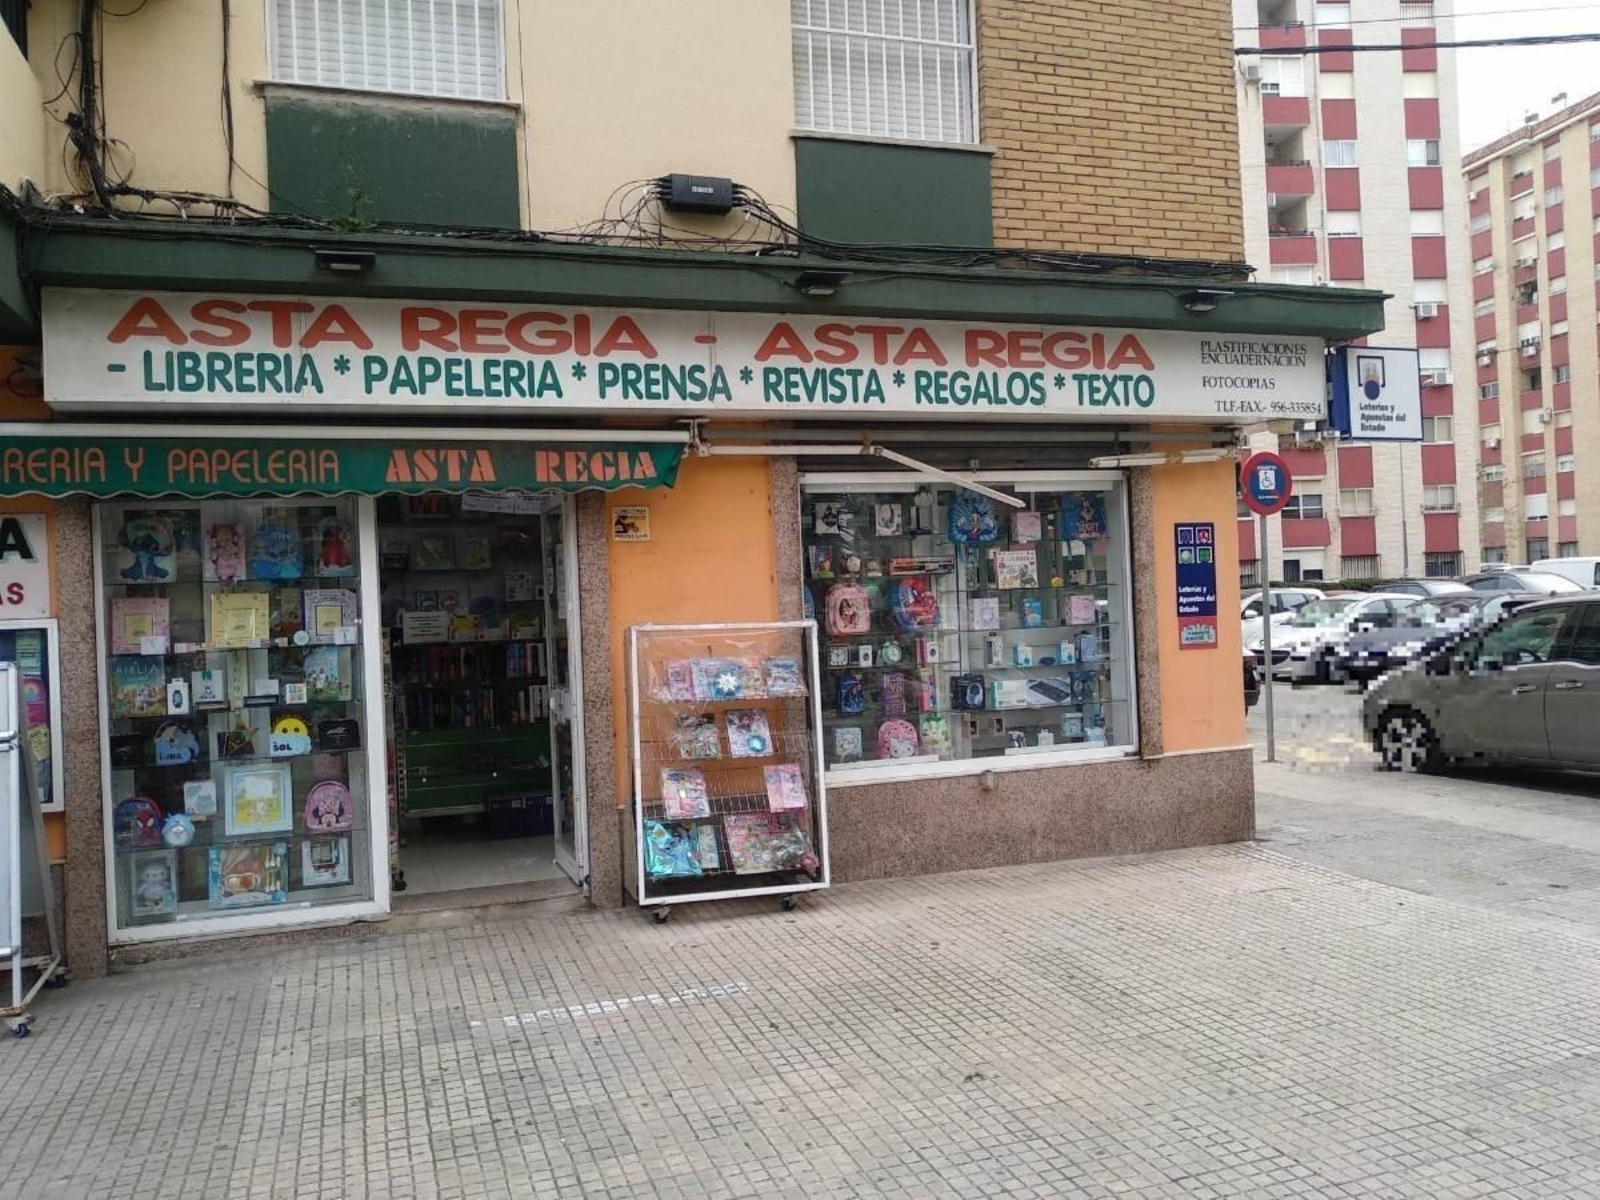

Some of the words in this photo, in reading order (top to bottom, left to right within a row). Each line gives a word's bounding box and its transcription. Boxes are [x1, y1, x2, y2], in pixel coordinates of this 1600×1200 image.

[107, 299, 373, 351] ASTA
[400, 307, 657, 358] REGIA
[755, 321, 946, 367] ASTA
[964, 328, 1154, 370] REGIA
[1200, 341, 1307, 355] PLASTIFICACIONES
[142, 349, 323, 395] LIBRERIA
[362, 354, 564, 401] PAPELERIA
[597, 361, 731, 403] PRENSA
[763, 366, 886, 405] REVISTA
[914, 368, 1046, 407] REGALOS
[1072, 374, 1156, 408] TEXTO
[1202, 376, 1276, 390] FOTOCOPIAS
[123, 446, 146, 482] Y
[167, 446, 341, 485] PAPELERIA
[385, 447, 498, 483] ASTA
[533, 448, 657, 483] REGIA
